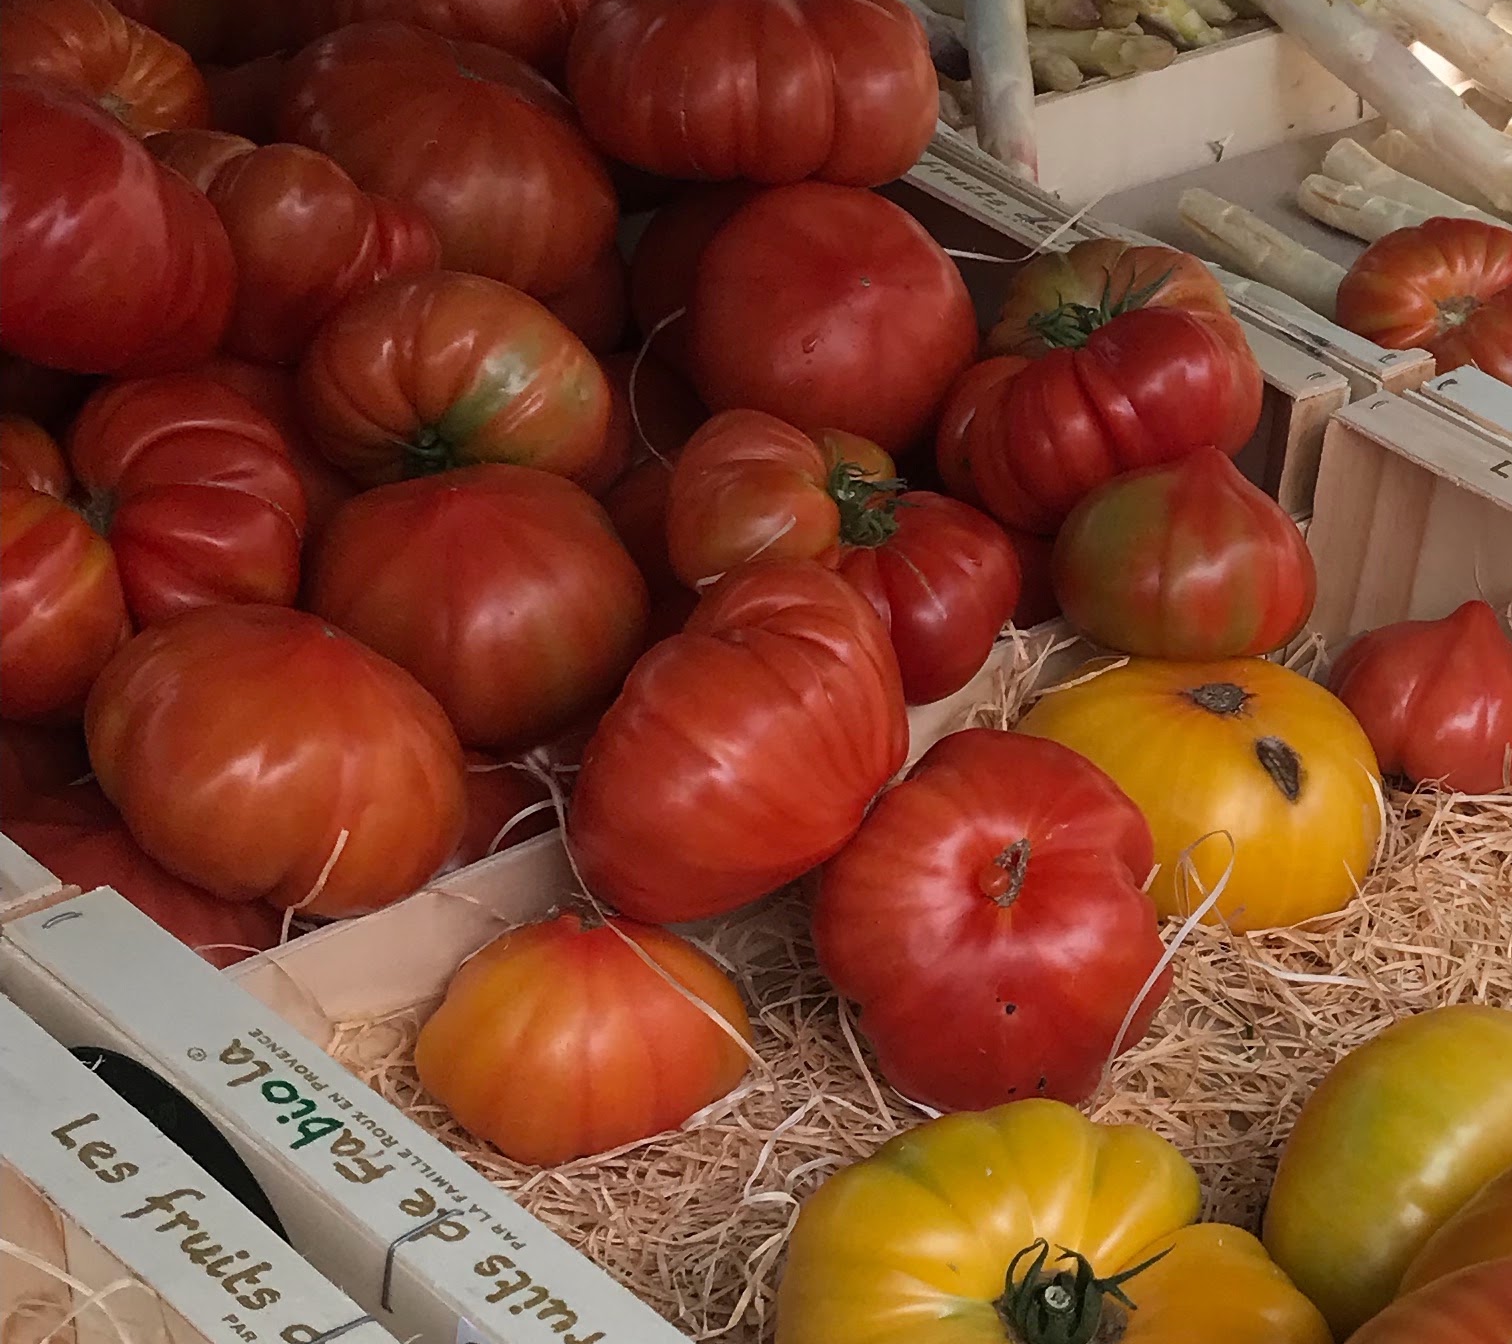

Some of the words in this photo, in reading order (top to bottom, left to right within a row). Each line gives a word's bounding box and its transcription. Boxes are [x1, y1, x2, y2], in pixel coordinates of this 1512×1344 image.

[247, 1027, 331, 1093] PROVENCE
[218, 1038, 397, 1185] Fabiola
[328, 1091, 354, 1111] EN
[351, 1110, 400, 1149] ROUX
[397, 1147, 468, 1204] FAMILLE
[51, 1112, 140, 1184] Les
[120, 1188, 282, 1311] fruits
[399, 1187, 471, 1243] de
[467, 1202, 493, 1223] LA
[490, 1223, 527, 1251] PAR
[221, 1313, 258, 1344] PAR
